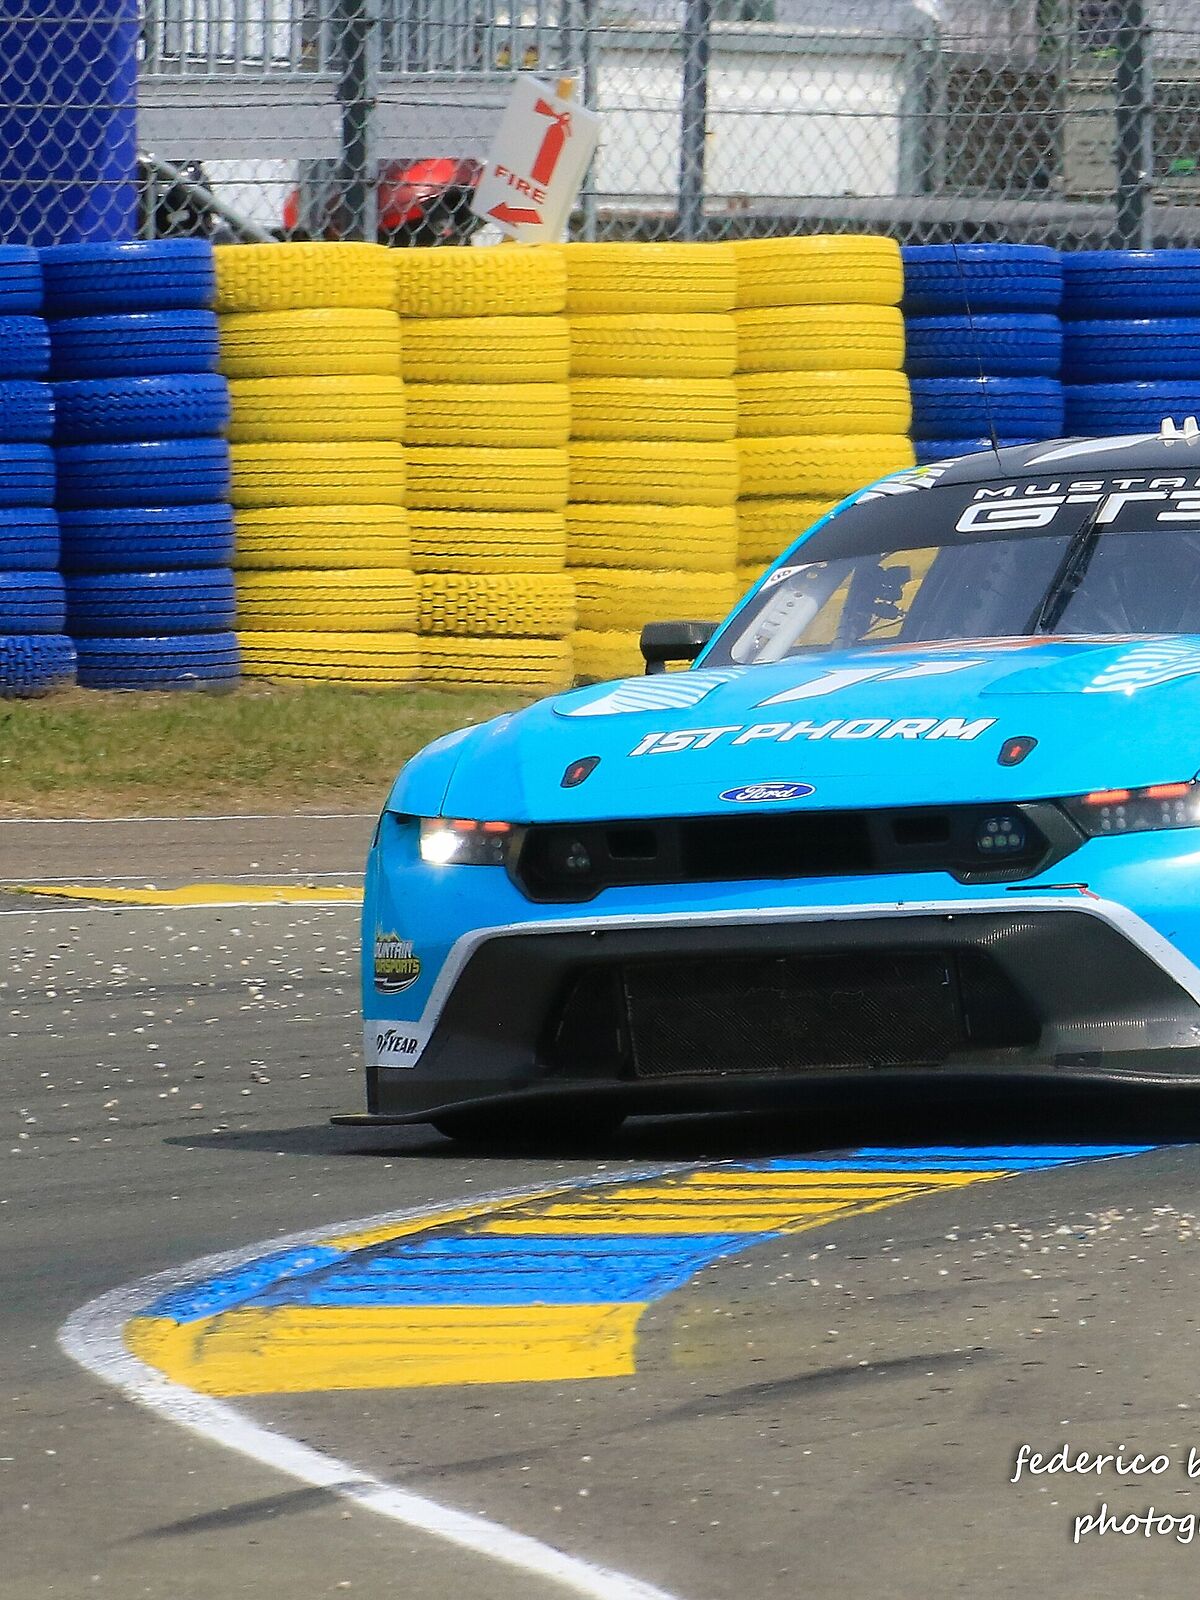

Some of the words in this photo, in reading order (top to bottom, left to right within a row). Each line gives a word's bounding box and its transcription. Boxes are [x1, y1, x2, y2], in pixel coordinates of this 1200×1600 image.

[494, 165, 547, 204] FIRE
[627, 725, 745, 757] 1ST
[730, 718, 998, 745] PHORM
[736, 785, 798, 800] Ford
